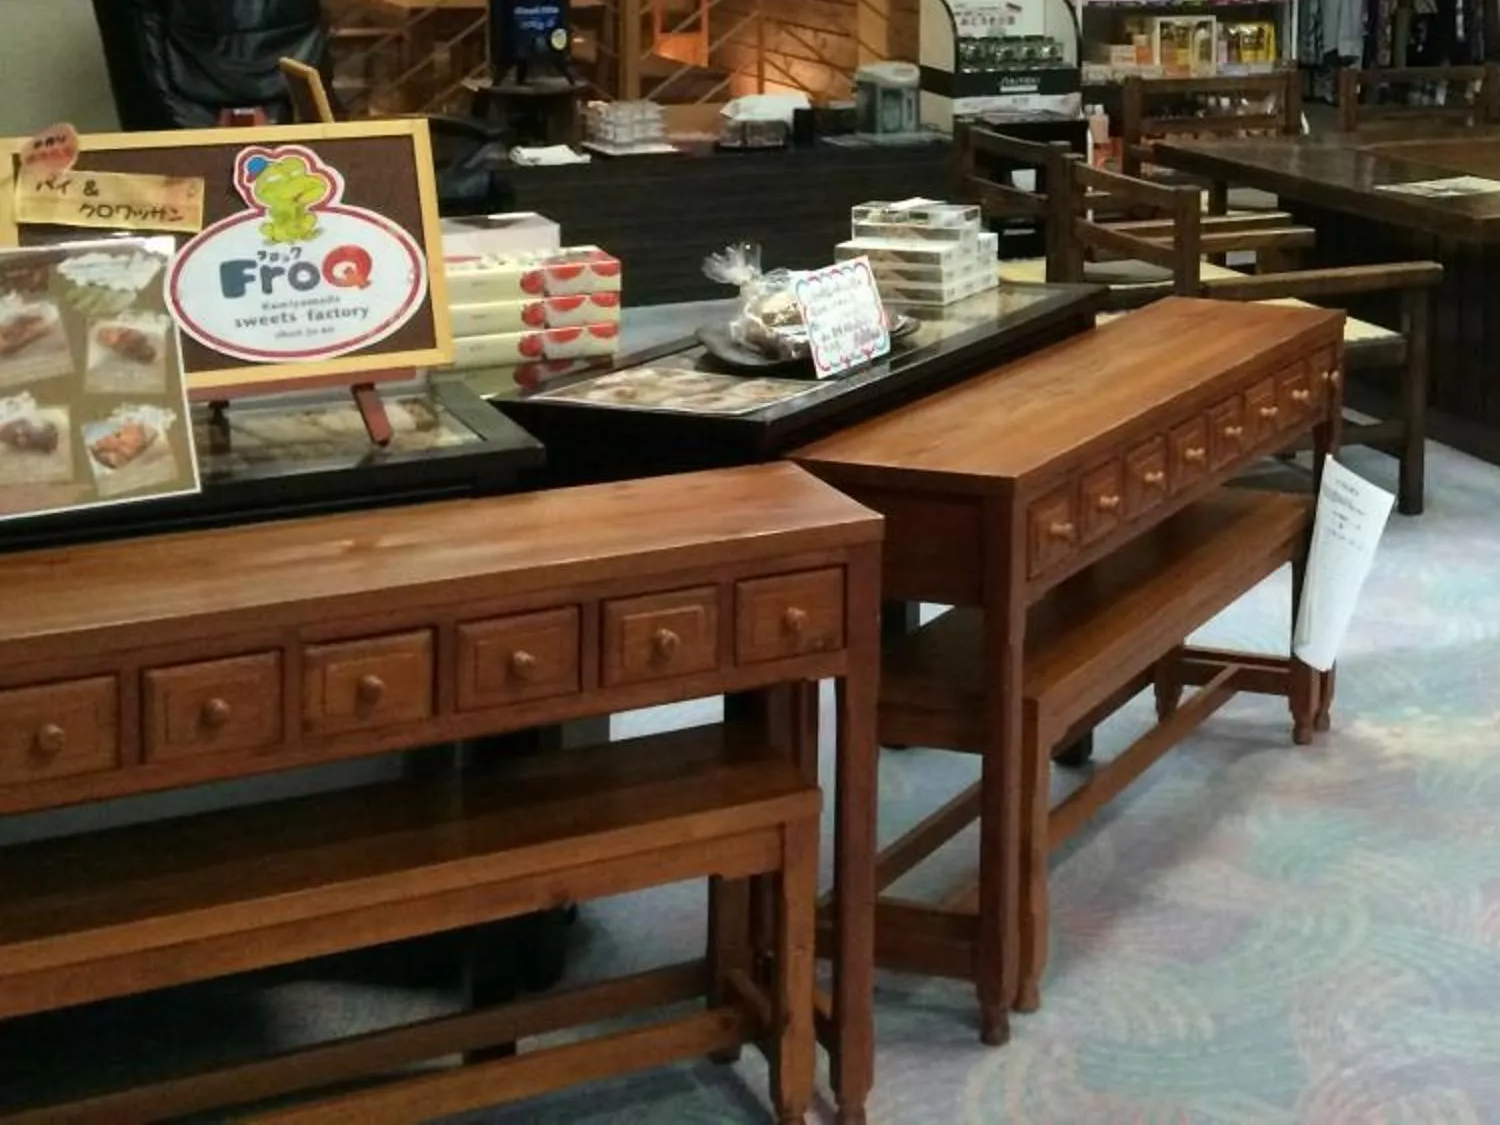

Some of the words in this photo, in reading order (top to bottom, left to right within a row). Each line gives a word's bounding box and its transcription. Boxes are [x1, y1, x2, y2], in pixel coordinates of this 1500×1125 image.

[83, 180, 99, 197] &
[79, 203, 184, 223] クロワッサン
[219, 244, 372, 299] FroQ
[234, 311, 297, 328] sweets
[307, 305, 370, 321] factory
